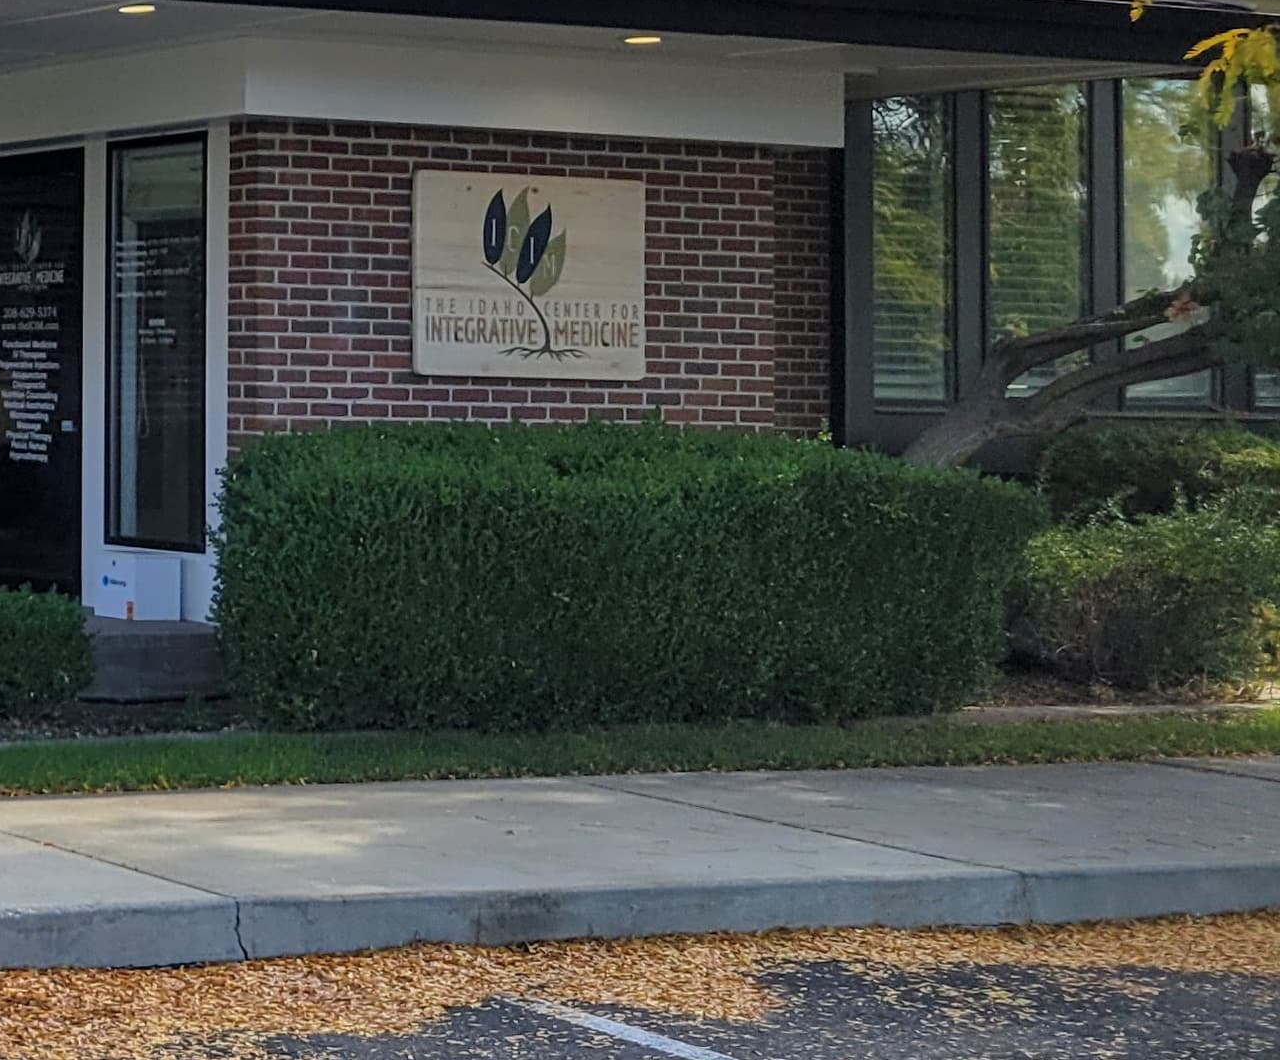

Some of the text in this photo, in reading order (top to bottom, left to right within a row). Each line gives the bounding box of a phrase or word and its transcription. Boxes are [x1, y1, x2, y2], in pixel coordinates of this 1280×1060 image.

[425, 297, 640, 320] THE IDAHO CENTER FOR
[424, 315, 640, 349] INTEGRATIVE MEDICINE
